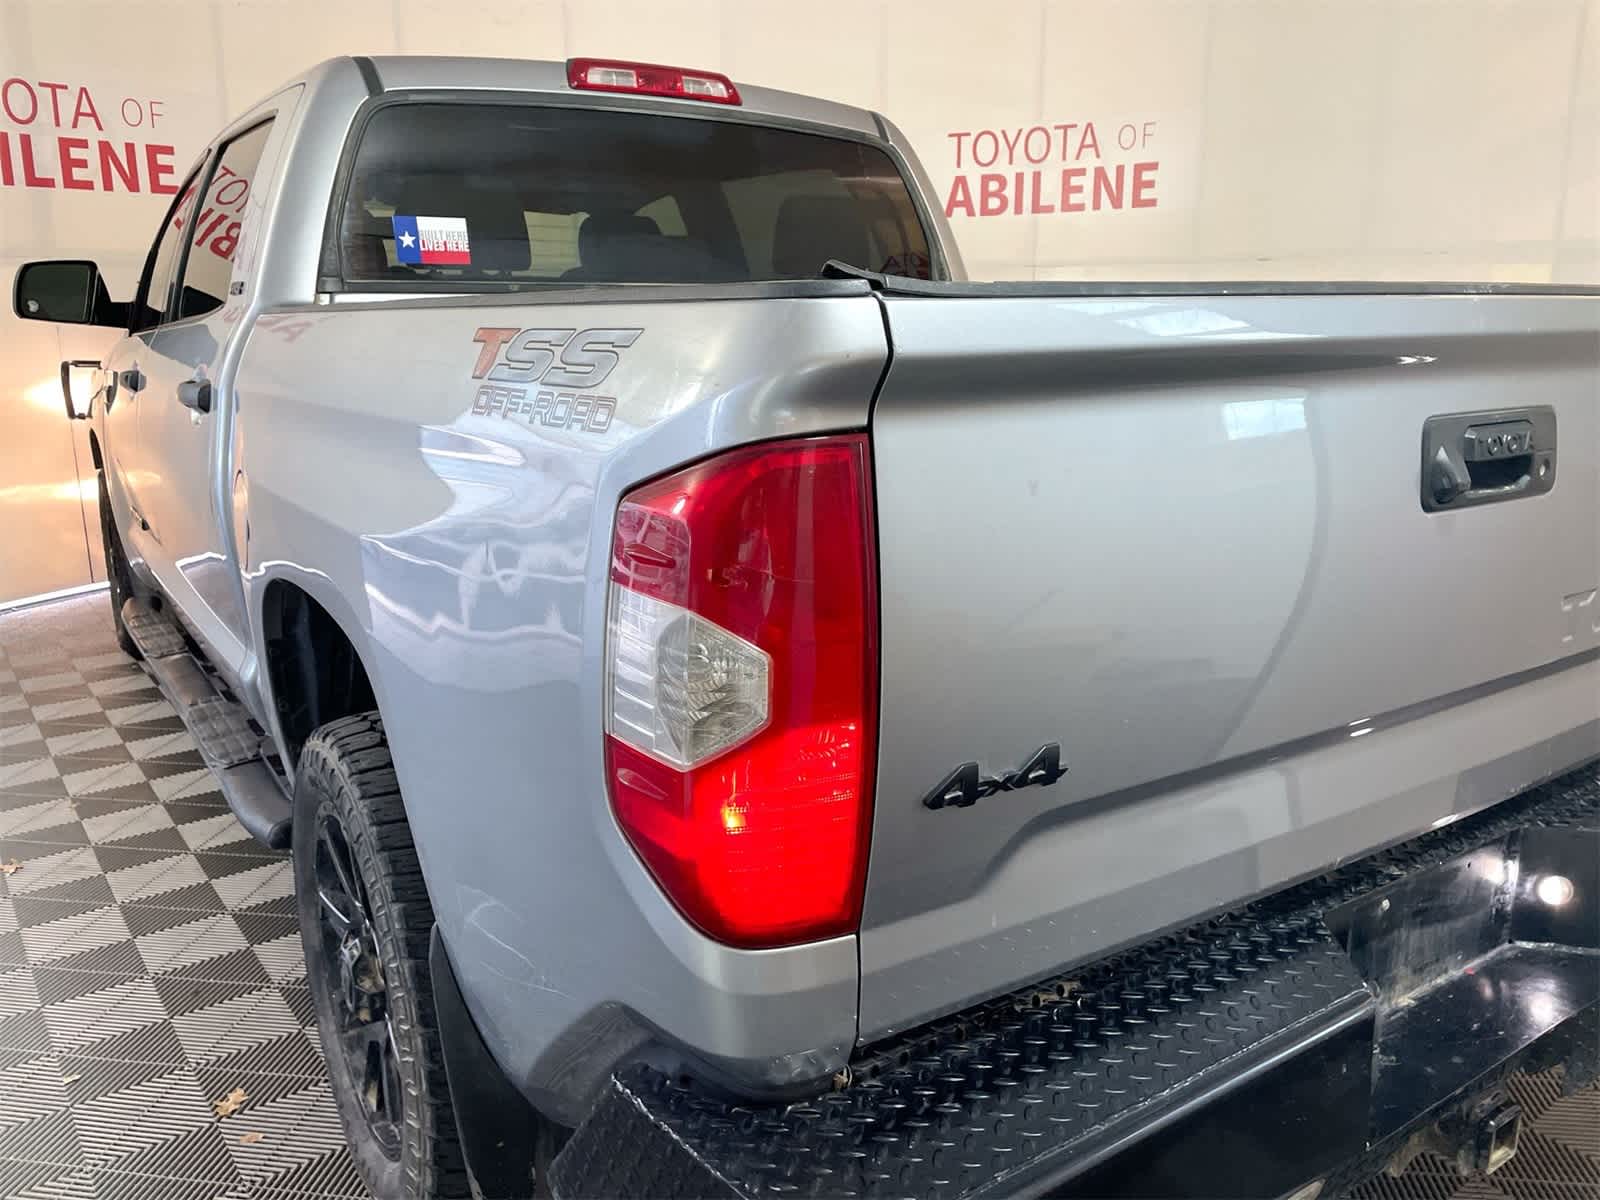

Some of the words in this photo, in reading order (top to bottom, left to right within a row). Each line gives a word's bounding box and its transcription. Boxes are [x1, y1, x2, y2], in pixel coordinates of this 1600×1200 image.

[121, 98, 163, 129] OF
[948, 122, 1100, 168] TOYOTA
[1118, 121, 1156, 150] OF
[945, 162, 1159, 218] ABILENE
[419, 239, 445, 251] LIVES
[446, 240, 470, 252] HERE
[445, 231, 468, 241] HERE
[472, 327, 645, 388] TSS
[471, 385, 617, 433] OFF-ROAD
[922, 742, 1069, 810] 4x4
